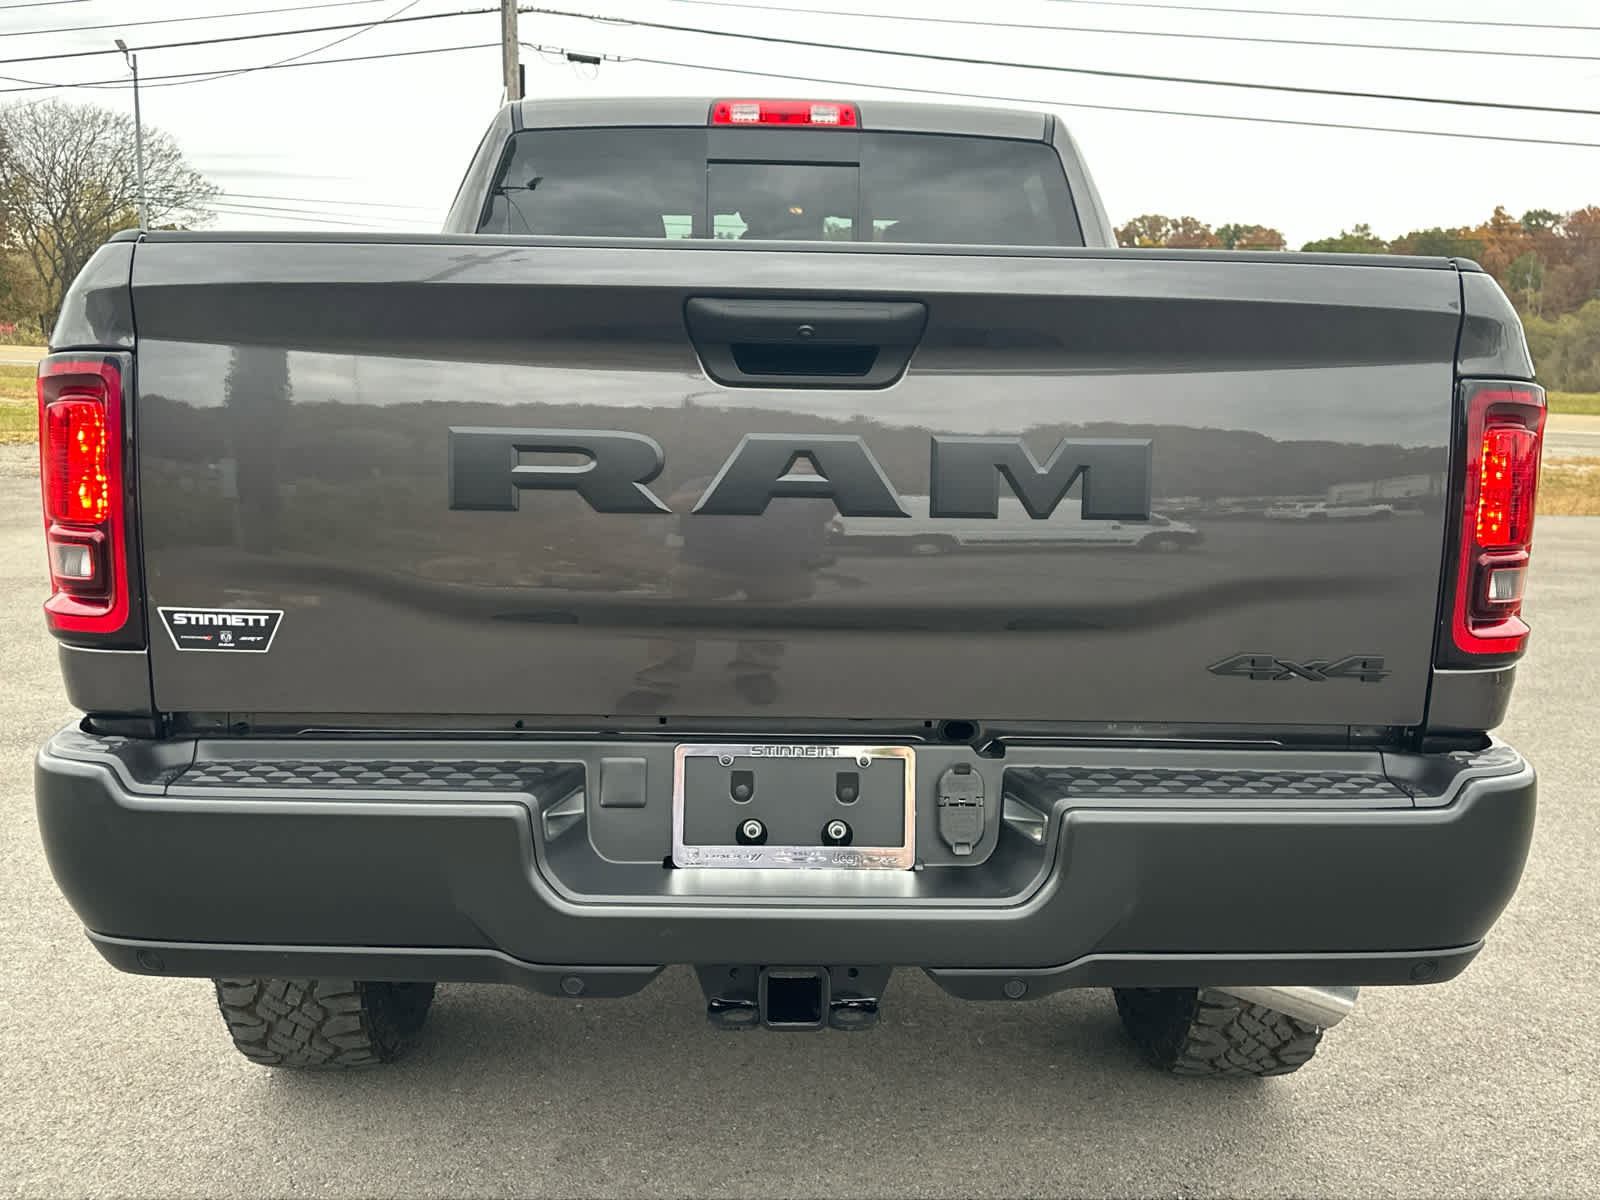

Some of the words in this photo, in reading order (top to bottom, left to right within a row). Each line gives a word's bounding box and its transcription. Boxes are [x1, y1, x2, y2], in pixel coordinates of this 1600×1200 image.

[448, 425, 1152, 520] RAM
[173, 613, 269, 627] STINNETT
[751, 745, 840, 757] STINNETT
[832, 851, 859, 866] Jeep
